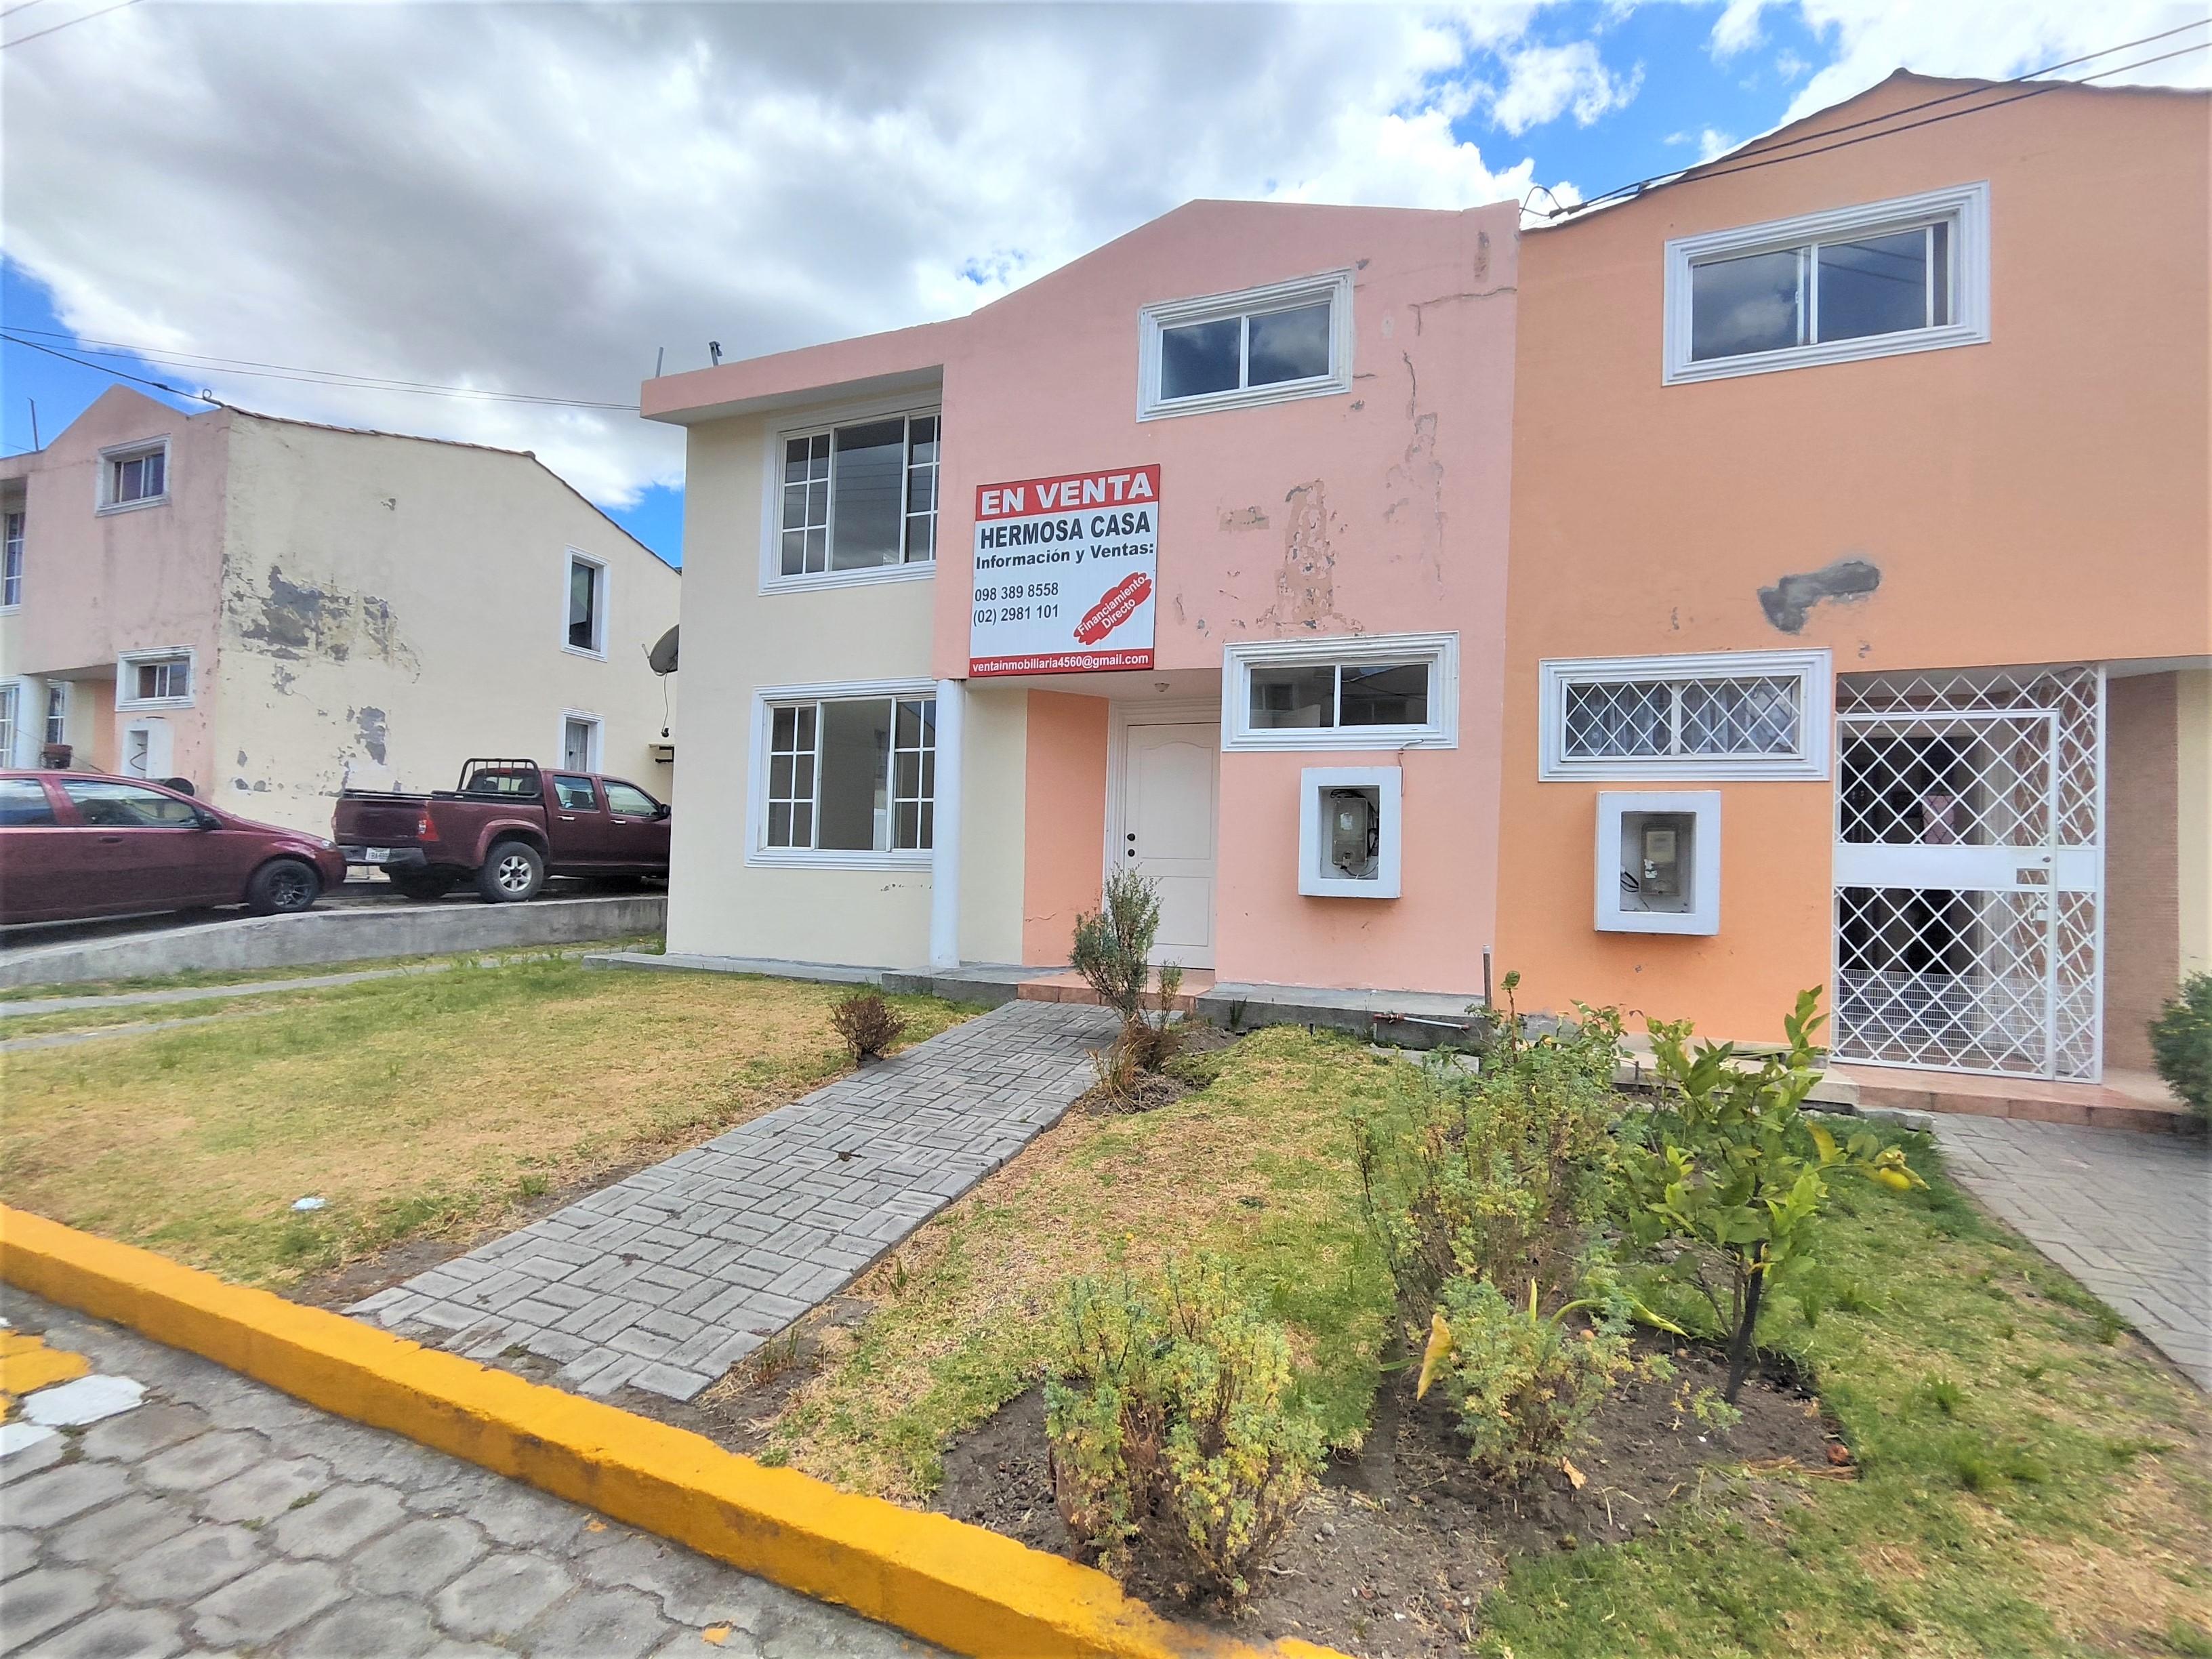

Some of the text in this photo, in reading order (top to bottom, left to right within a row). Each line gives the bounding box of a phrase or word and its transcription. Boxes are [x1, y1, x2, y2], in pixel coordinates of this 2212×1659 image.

[981, 472, 1153, 515] EN VENTA
[981, 511, 1151, 549] HERMOSA CASA
[976, 543, 1154, 569] Información y Ventas:
[975, 582, 1059, 602] 098 389 8558
[1077, 575, 1145, 636] Financiamiento
[973, 604, 1059, 627] (02) 2981 101
[1101, 598, 1136, 630] Directo
[972, 654, 1149, 672] ventainmobiliaria4560@gmail.com
